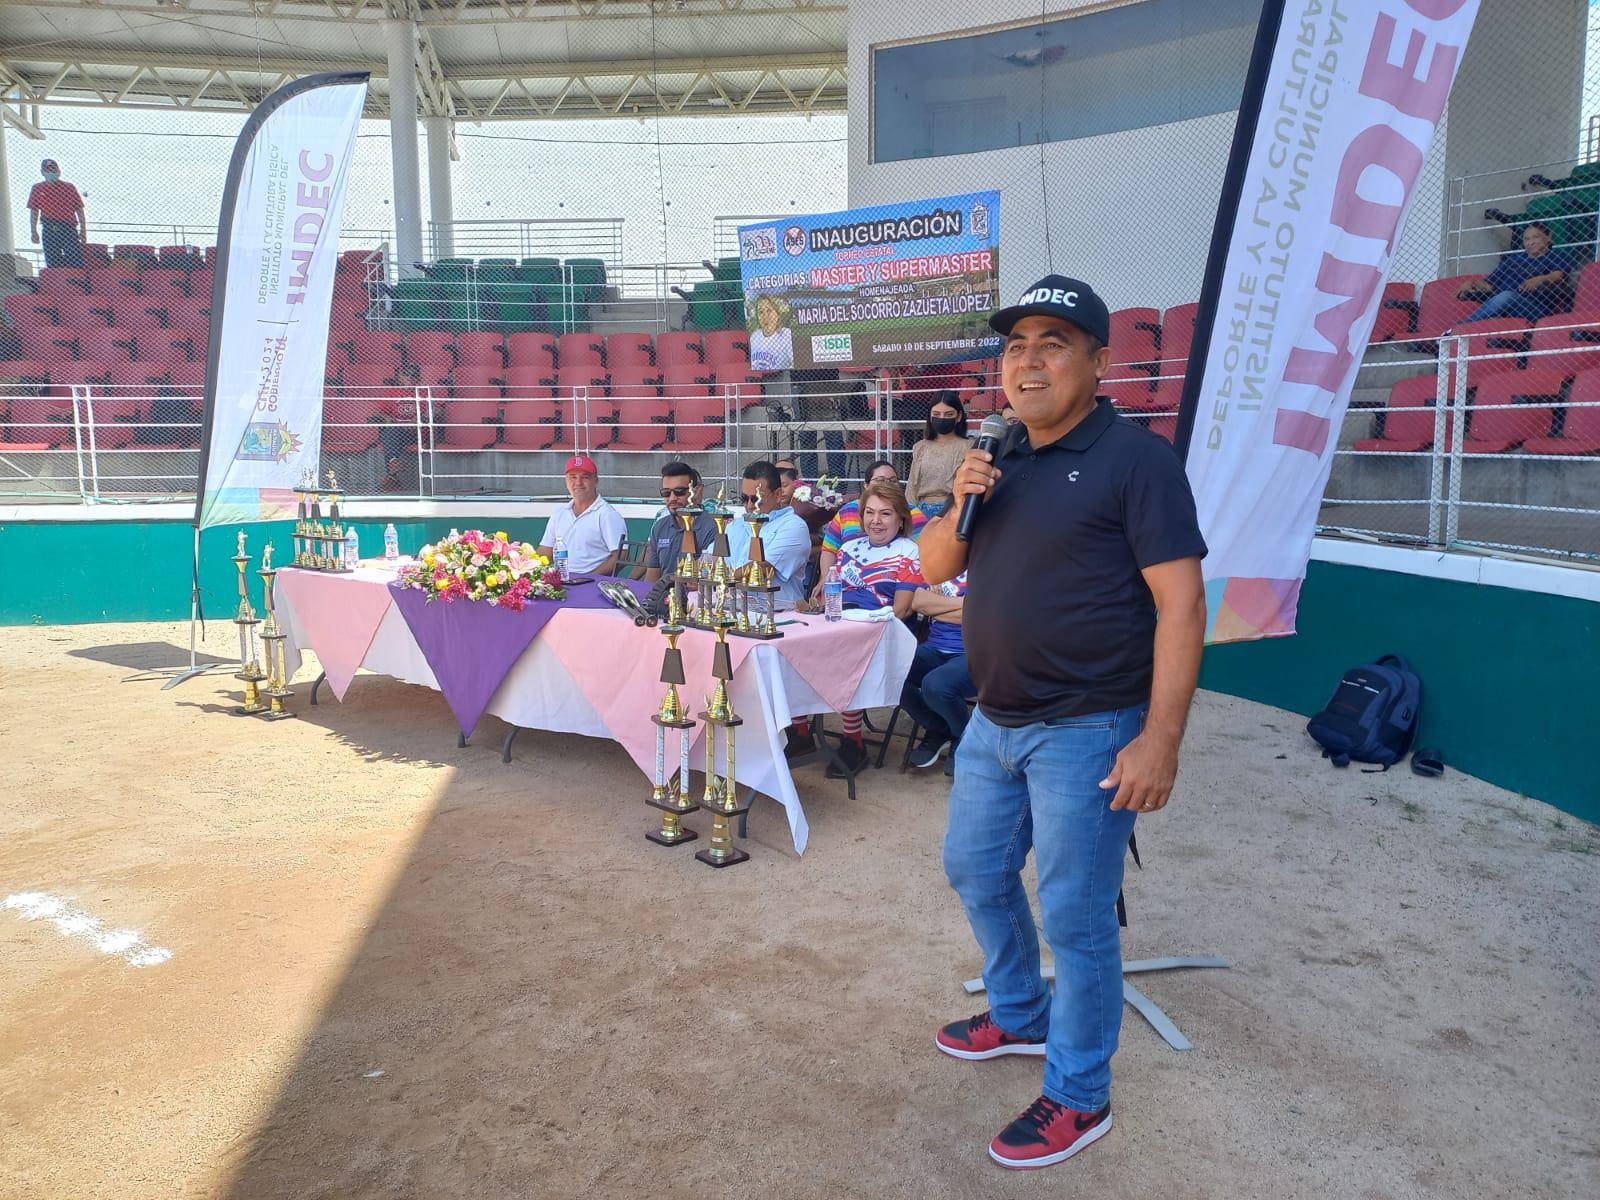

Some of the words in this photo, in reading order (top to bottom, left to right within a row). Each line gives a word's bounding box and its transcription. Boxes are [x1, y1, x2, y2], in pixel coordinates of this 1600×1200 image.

[811, 212, 960, 249] INAUGURACIÓN
[811, 263, 866, 287] MASTER
[868, 262, 879, 281] Y
[880, 251, 993, 281] SUPERMASTER
[798, 303, 829, 324] MARÍA
[830, 304, 850, 322] DEL
[851, 300, 901, 320] SOCORRO
[902, 297, 950, 317] ZAZUETA
[952, 290, 992, 314] LÓPEZ
[904, 342, 913, 352] 10
[914, 341, 924, 351] DE
[925, 339, 977, 351] SEPTIEMBRE
[978, 337, 1000, 347] 2022
